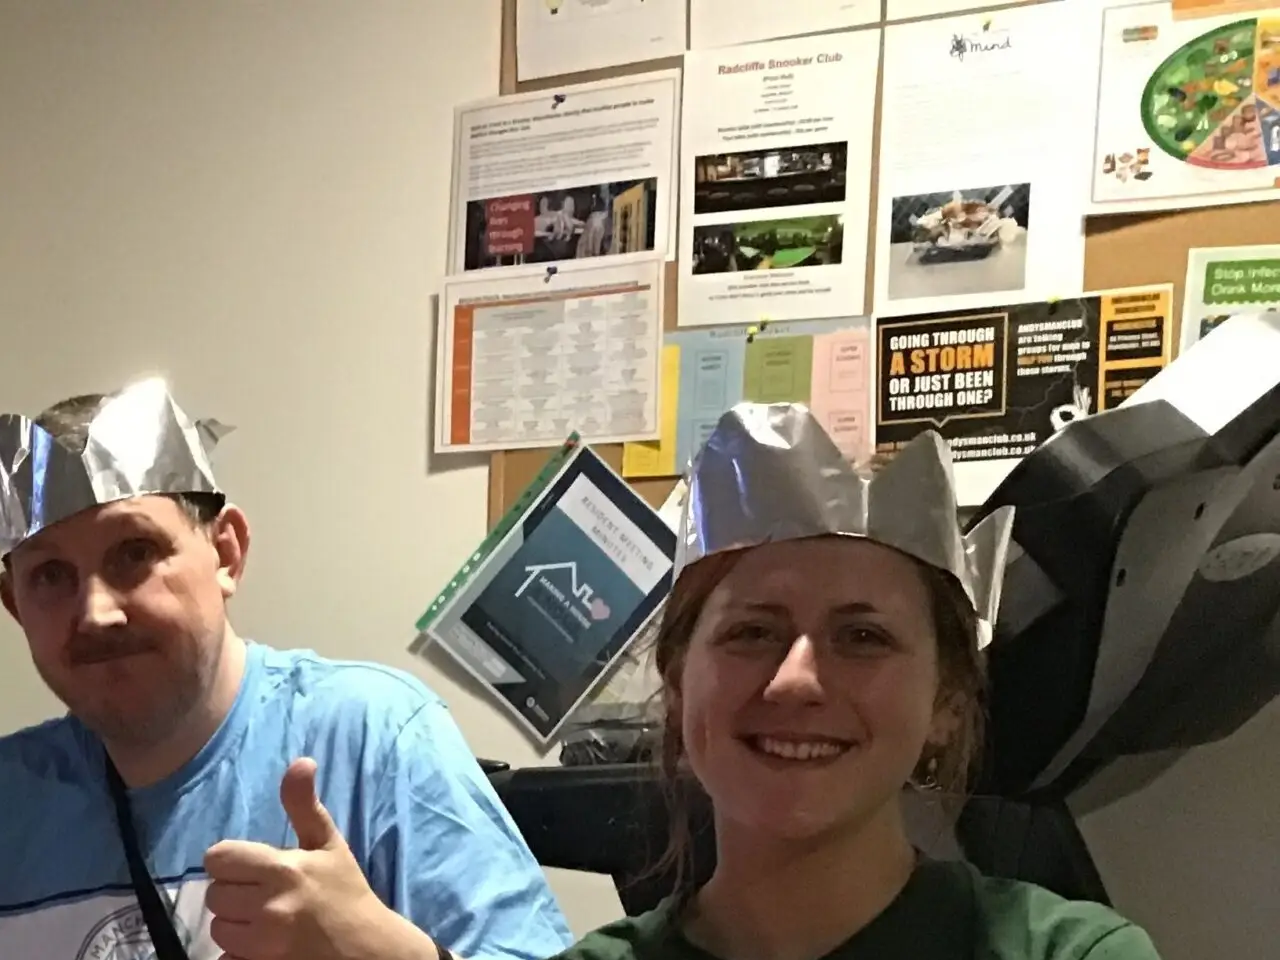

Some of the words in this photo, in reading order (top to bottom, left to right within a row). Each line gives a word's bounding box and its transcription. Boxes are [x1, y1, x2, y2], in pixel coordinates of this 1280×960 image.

[718, 61, 765, 75] Radcliffe
[768, 56, 813, 69] Snooker
[816, 52, 843, 63] Club
[889, 333, 930, 350] GOING
[932, 327, 995, 346] THROUGH
[889, 352, 906, 376] A
[910, 343, 995, 374] STORM
[889, 377, 910, 395] OR
[913, 373, 952, 393] JUST
[954, 370, 994, 389] BEEN
[889, 392, 954, 411] THROUGH
[956, 388, 993, 406] ONE?
[947, 432, 1036, 447] ndysmanclub.co.uk
